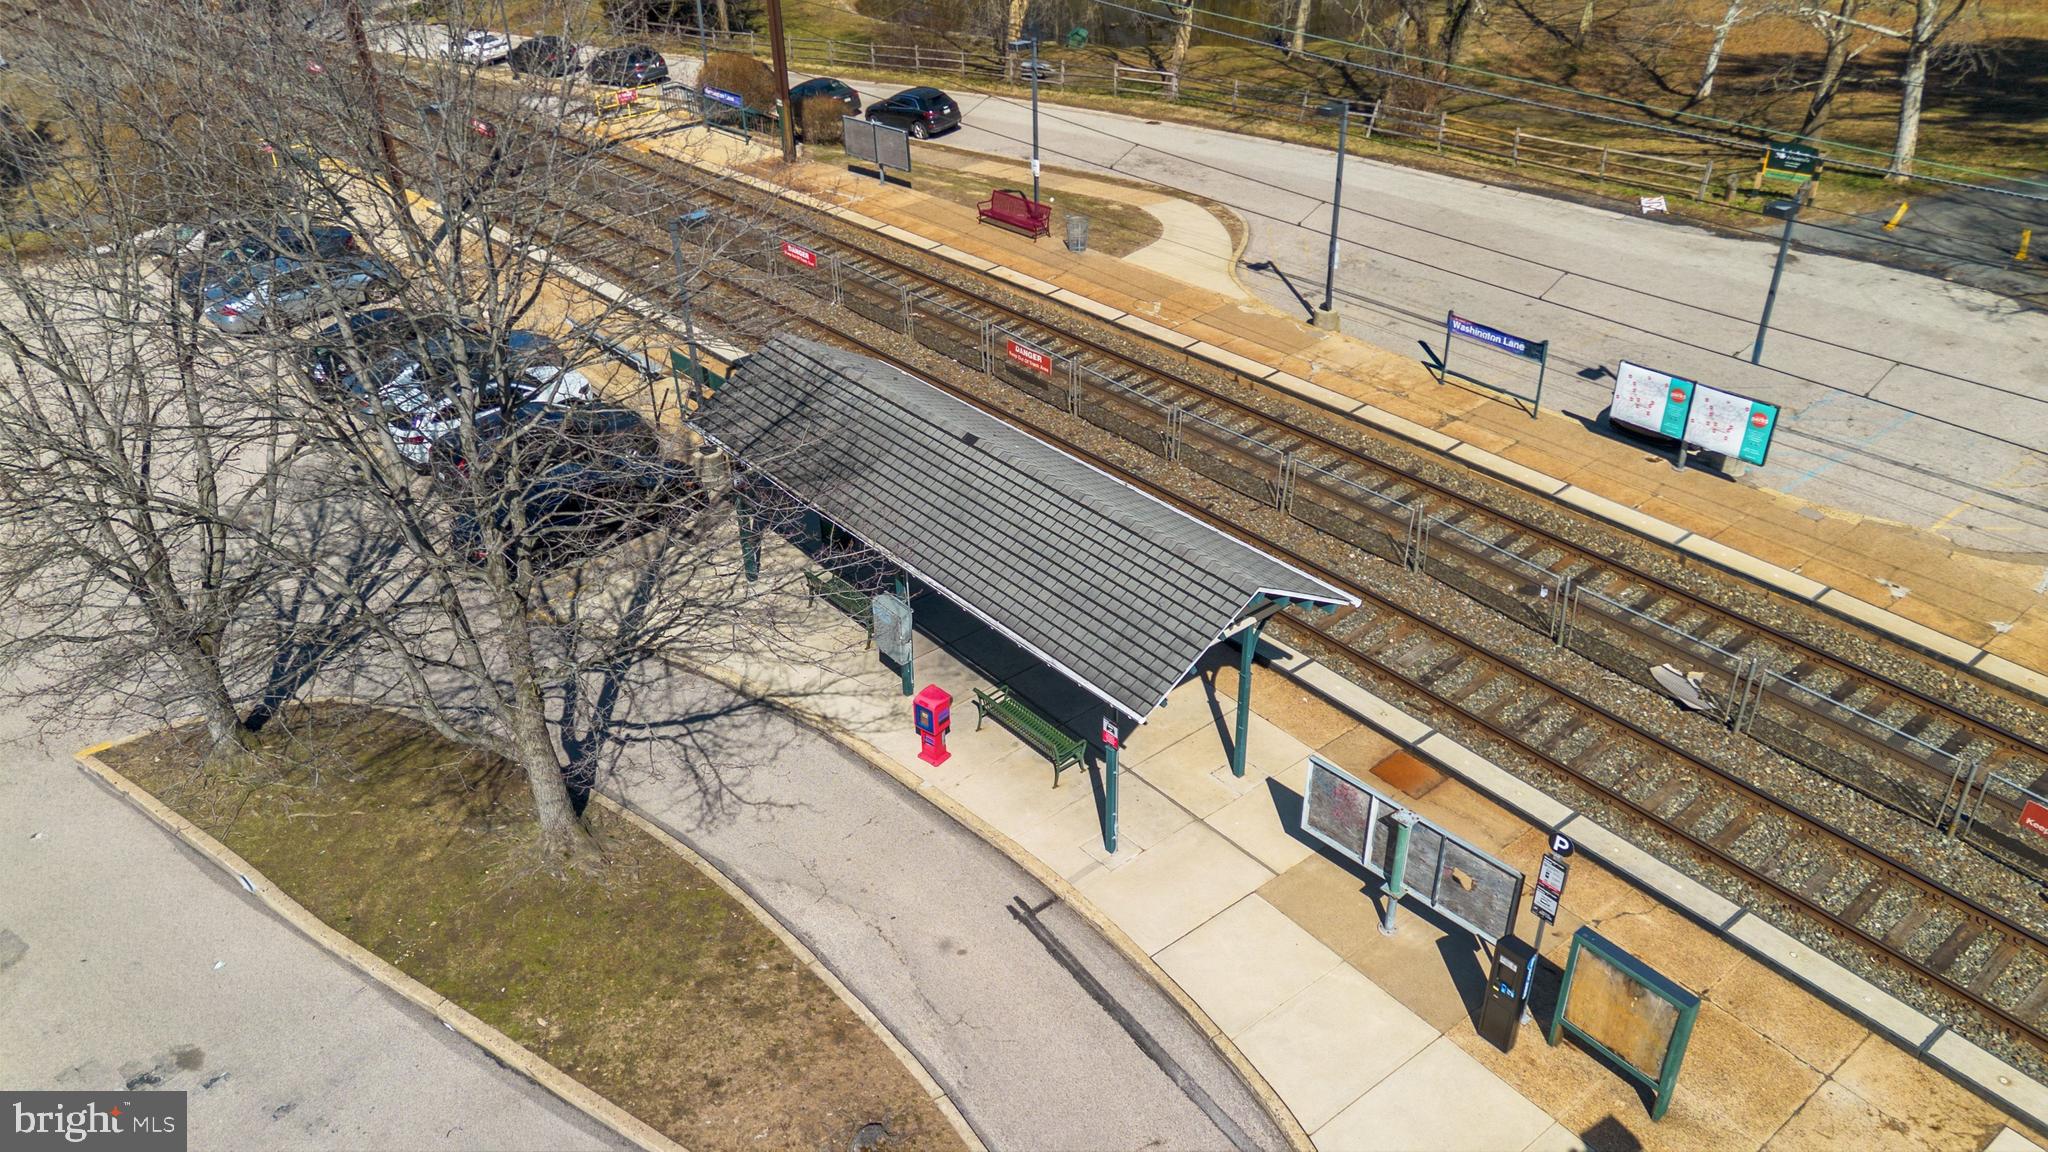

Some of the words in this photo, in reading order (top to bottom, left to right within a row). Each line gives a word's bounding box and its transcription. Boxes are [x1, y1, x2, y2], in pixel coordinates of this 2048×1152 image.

[1452, 320, 1501, 344] Washington
[1502, 336, 1526, 351] Lane
[1015, 345, 1043, 363] DANGER
[1553, 834, 1570, 851] P
